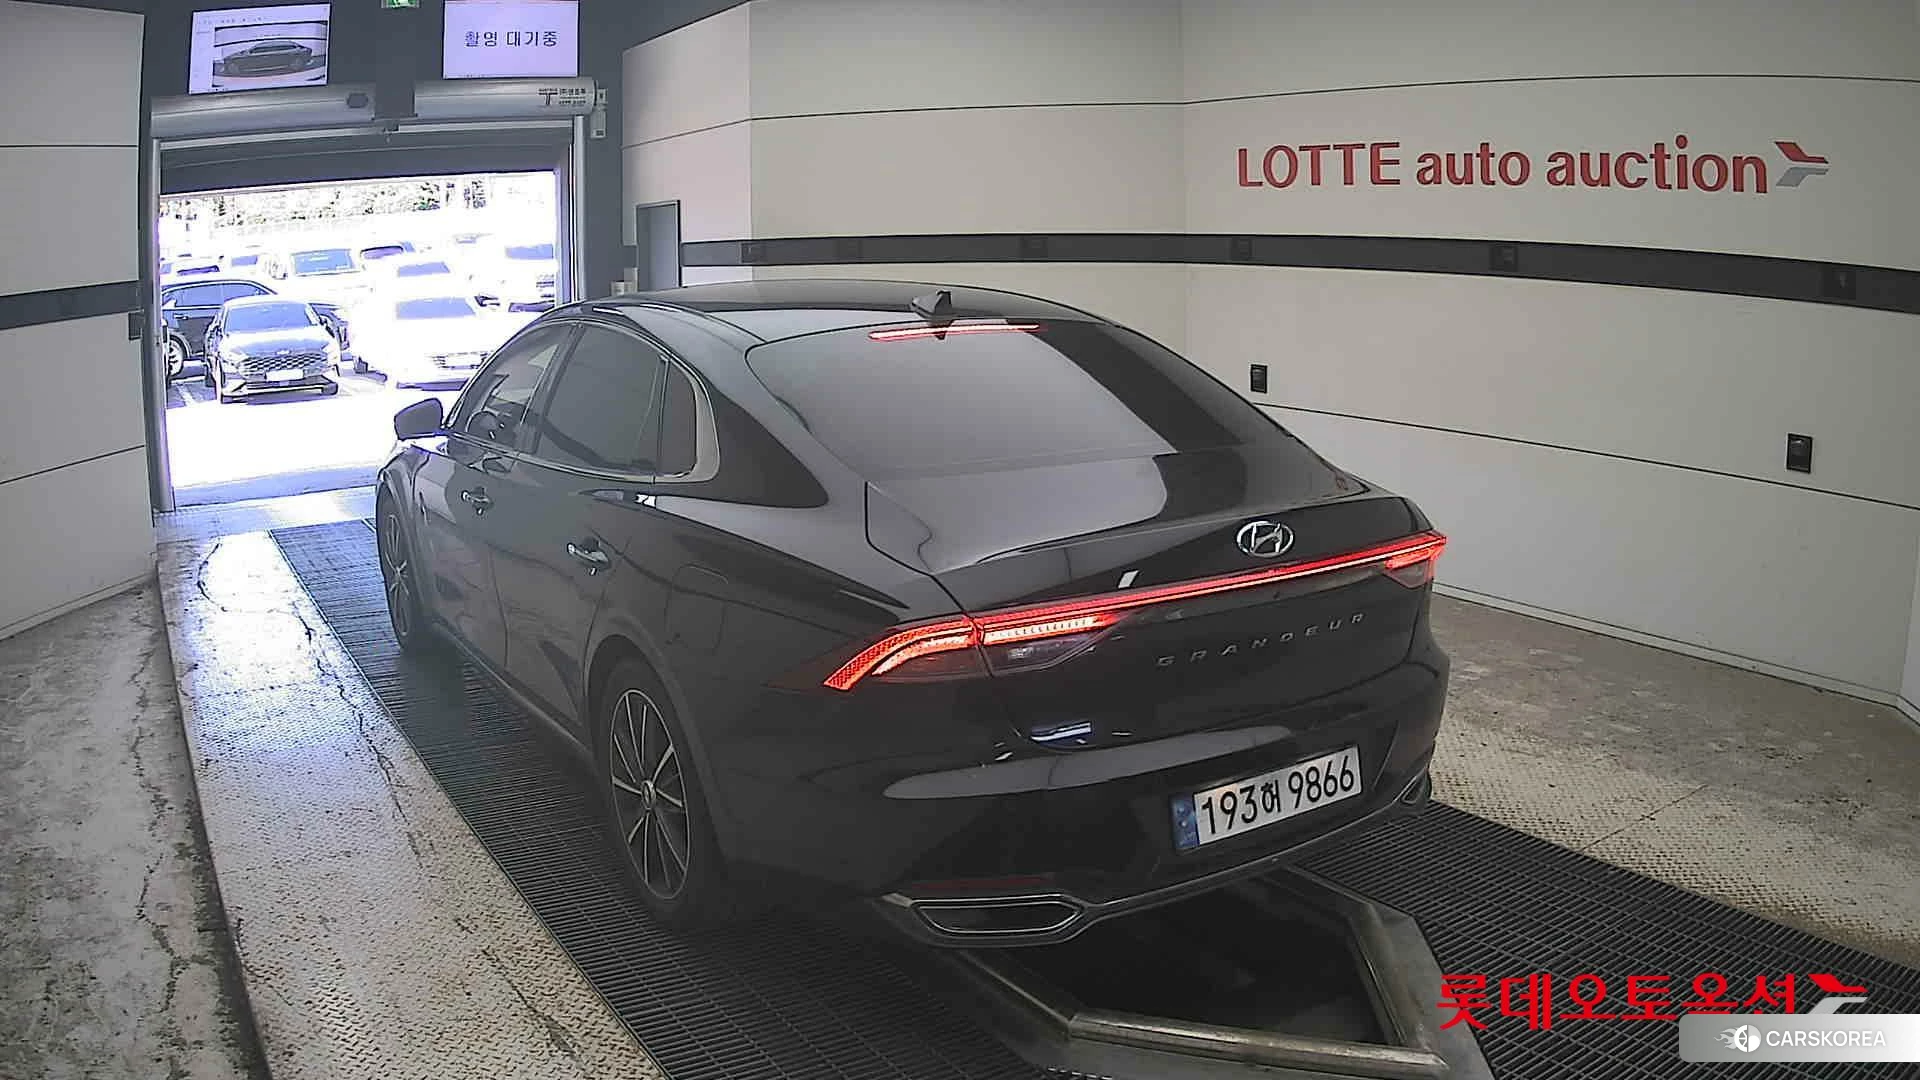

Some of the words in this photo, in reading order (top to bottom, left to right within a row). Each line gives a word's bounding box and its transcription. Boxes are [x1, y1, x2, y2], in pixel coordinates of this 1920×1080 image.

[506, 31, 558, 47] 대기중
[1238, 141, 1400, 188] LOTTE
[1416, 142, 1531, 187] auto
[1546, 135, 1768, 194] auction
[1157, 612, 1364, 666] GRANDEUR
[1202, 779, 1281, 834] 193허
[1287, 755, 1354, 809] 9866
